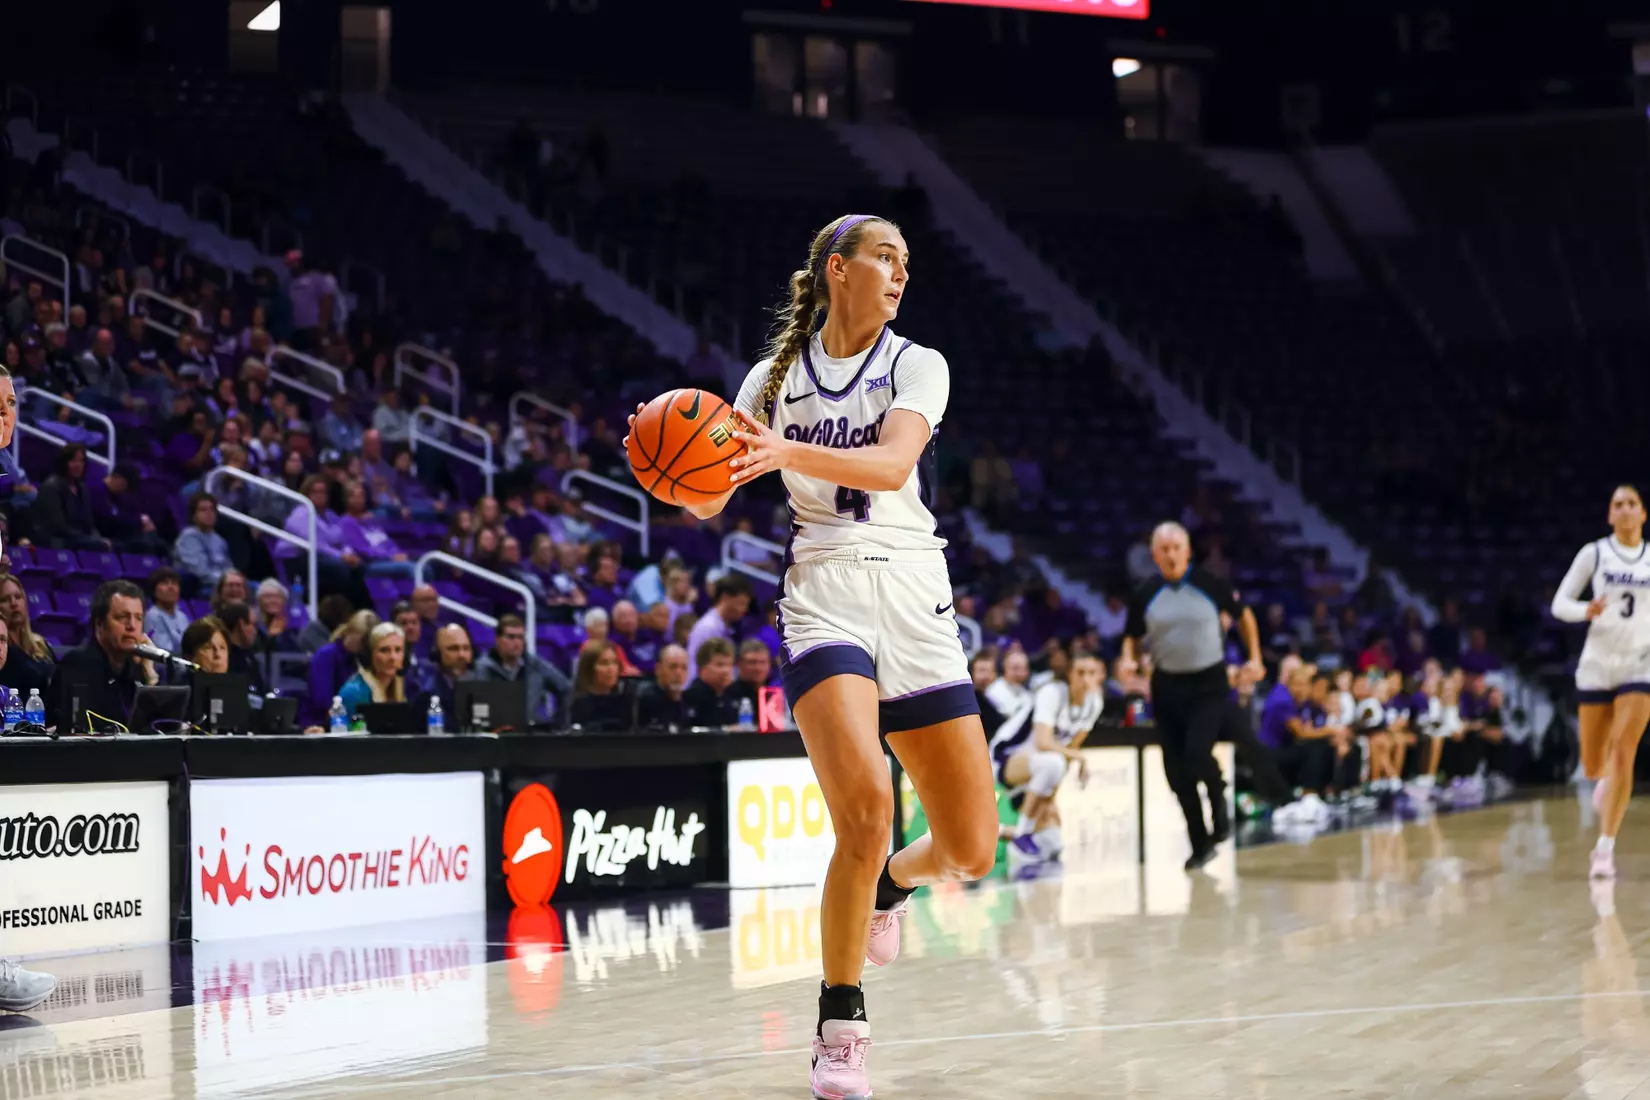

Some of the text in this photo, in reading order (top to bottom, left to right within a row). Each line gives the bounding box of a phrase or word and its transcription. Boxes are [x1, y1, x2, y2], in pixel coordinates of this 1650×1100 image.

[783, 409, 888, 450] Wildcat
[834, 484, 871, 523] 4
[1619, 590, 1635, 619] 3
[737, 783, 836, 862] QDO
[565, 805, 706, 884] Pizza Hut
[0, 898, 143, 929] FESSIONAL GRADE
